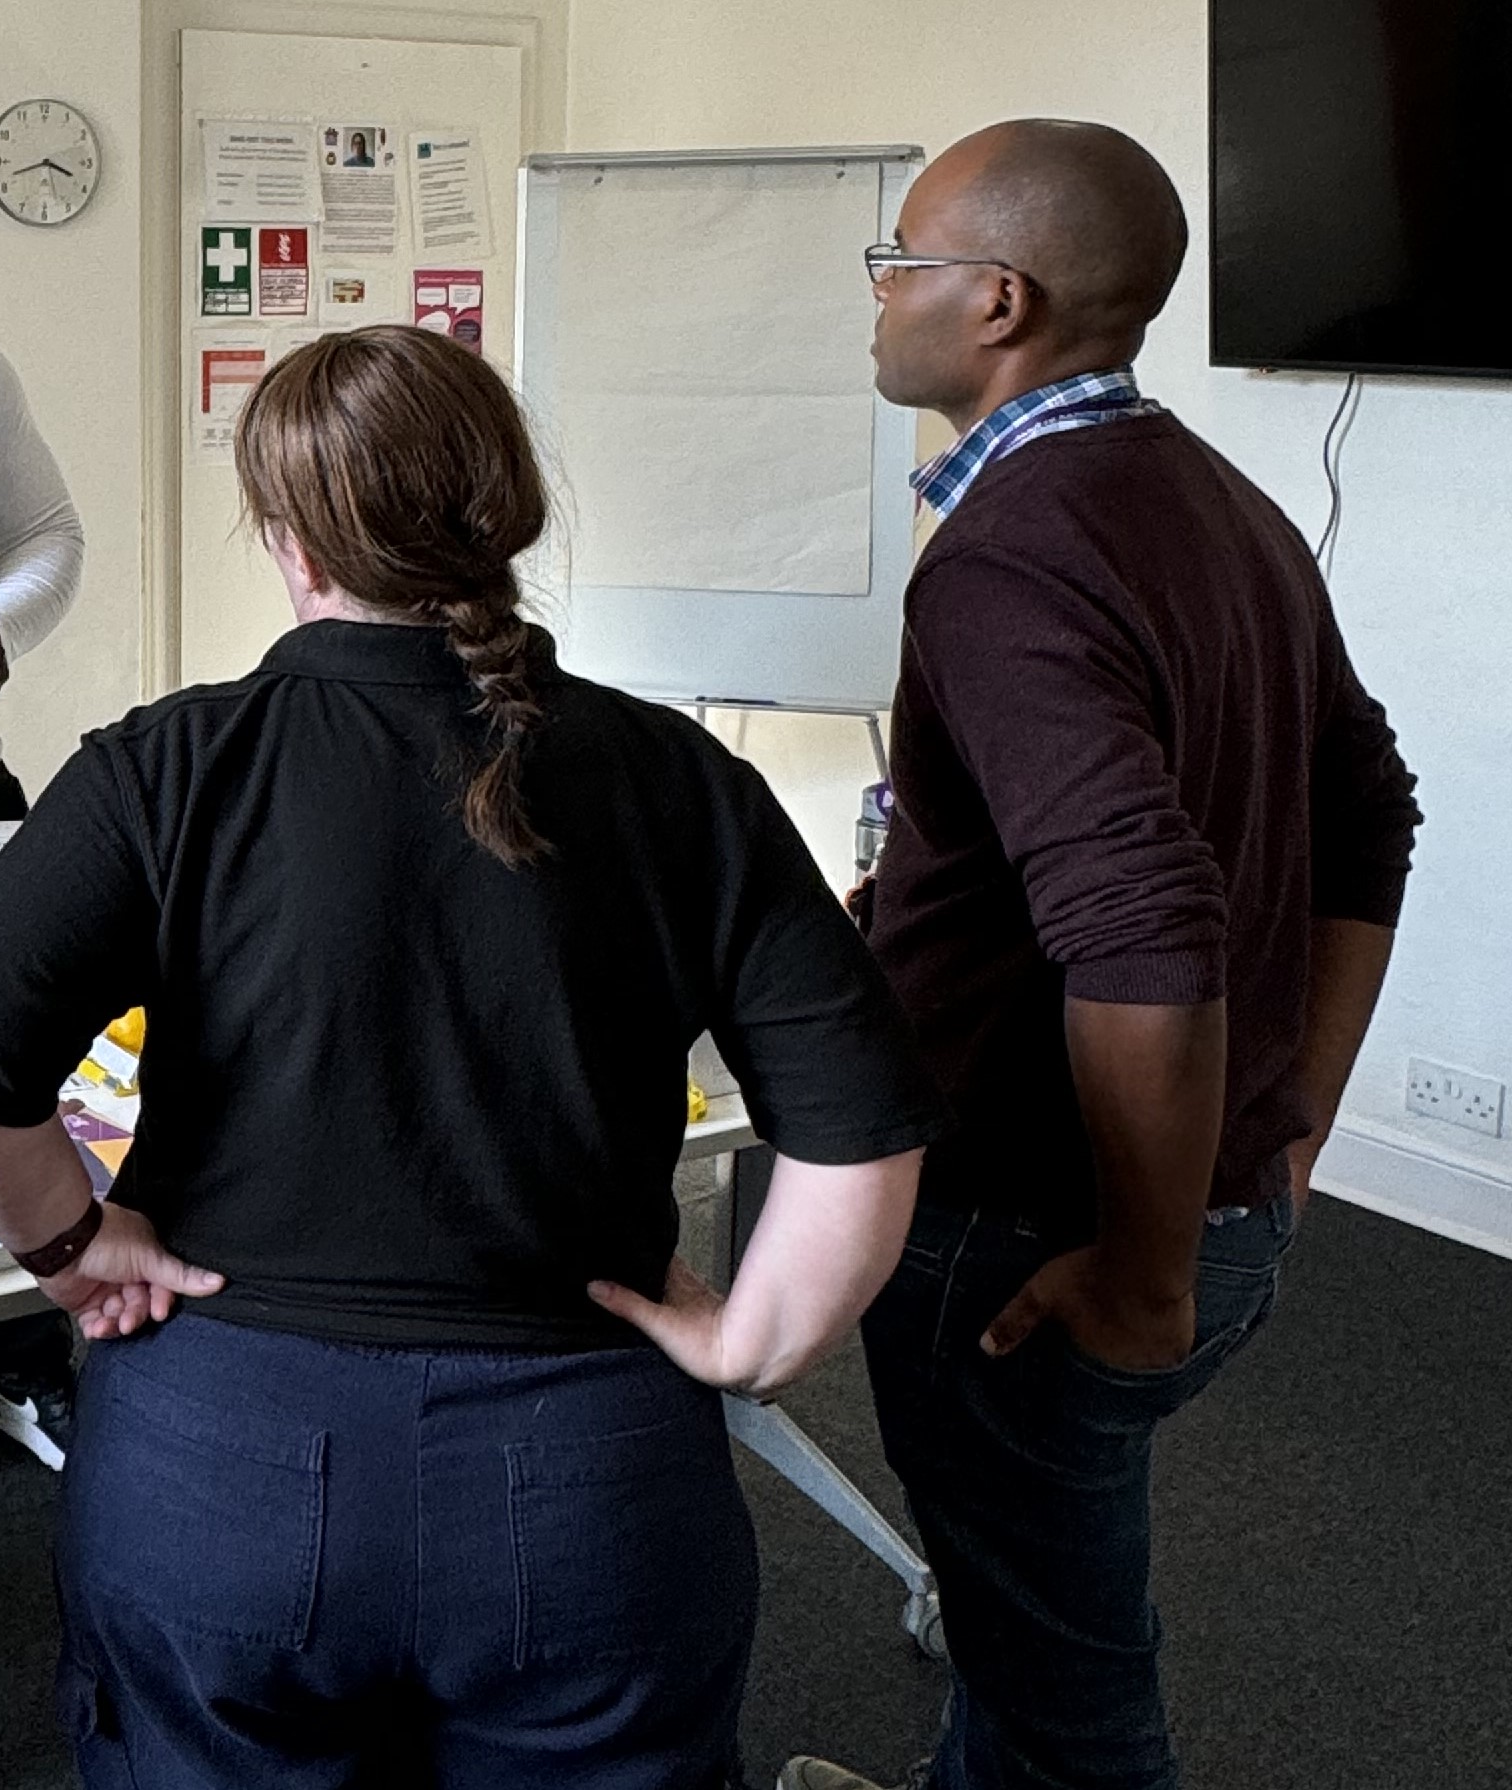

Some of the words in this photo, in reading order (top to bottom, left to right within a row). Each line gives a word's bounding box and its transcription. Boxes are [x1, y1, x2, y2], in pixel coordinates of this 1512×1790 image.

[39, 104, 50, 114] 12
[17, 110, 27, 121] 11
[0, 130, 10, 141] 10
[80, 129, 86, 141] 2
[87, 158, 93, 169] 3
[19, 203, 25, 213] 7
[65, 202, 71, 213] 5
